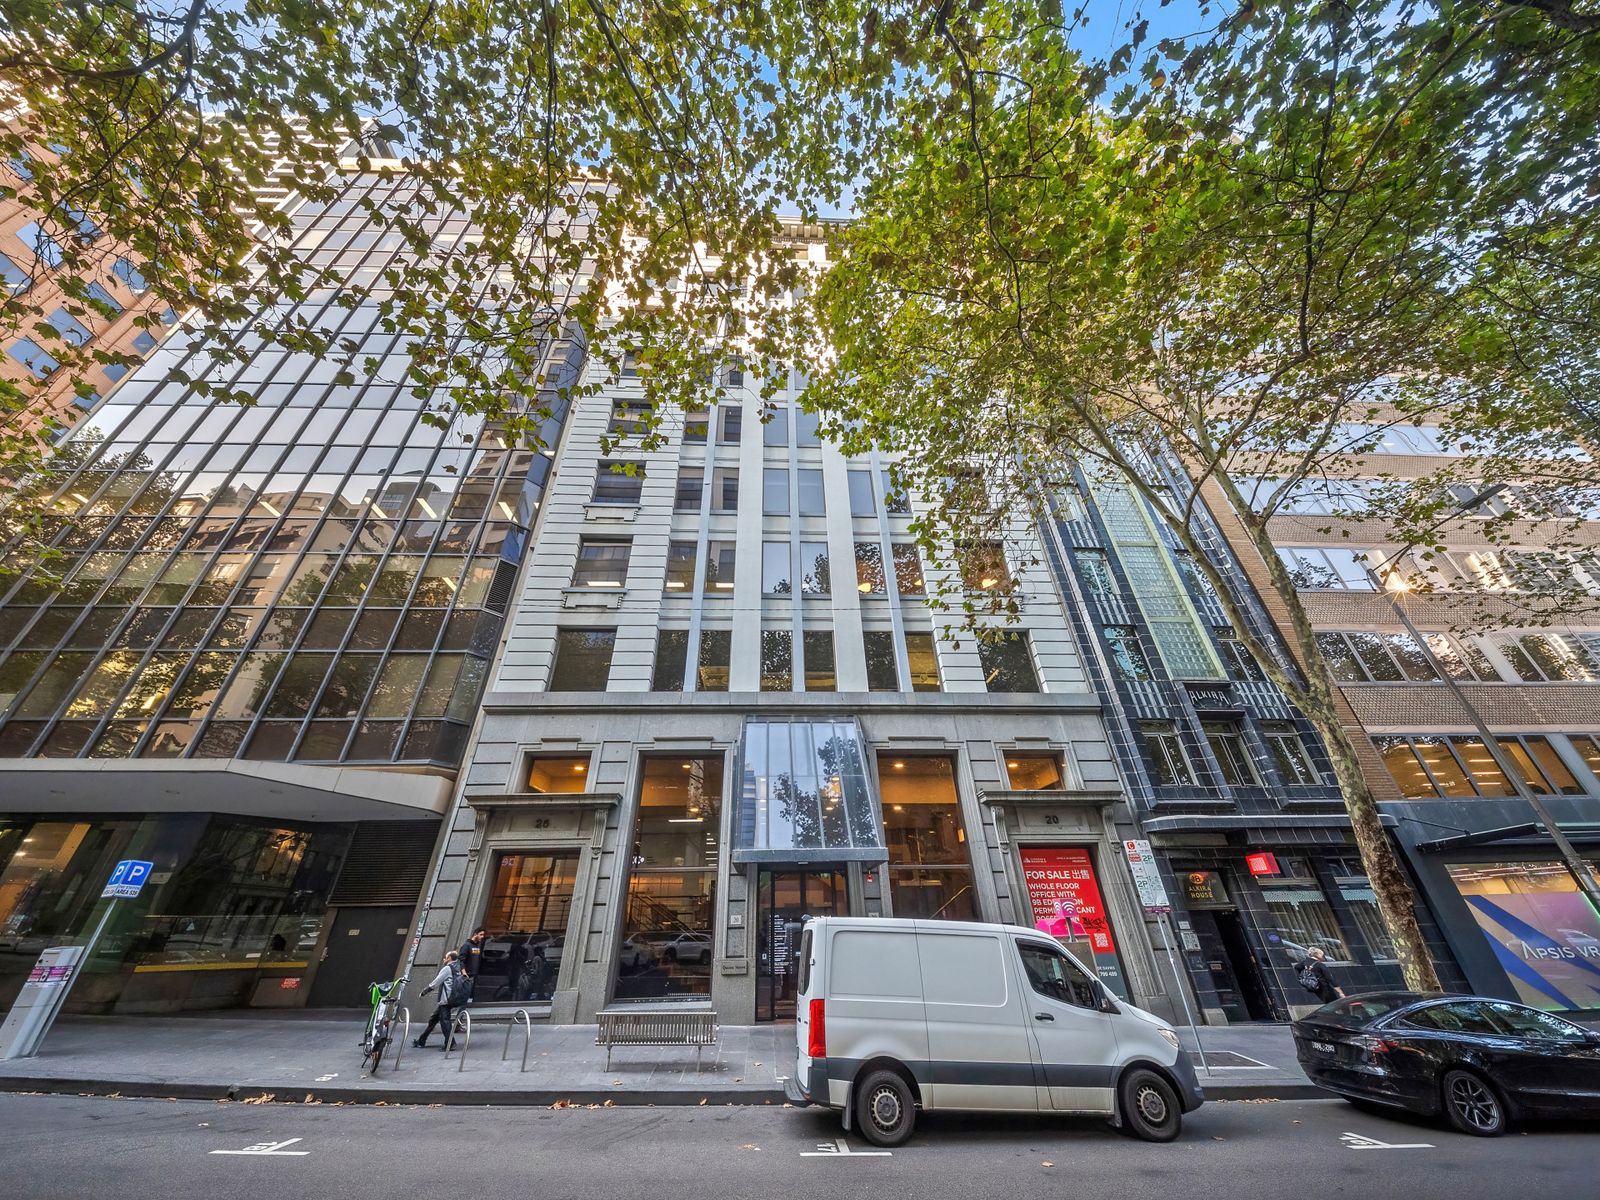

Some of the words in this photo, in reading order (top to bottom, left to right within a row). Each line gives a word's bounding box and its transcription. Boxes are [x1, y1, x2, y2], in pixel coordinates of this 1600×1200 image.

[1189, 691, 1229, 704] ALKIRA
[1045, 815, 1059, 825] 20
[1142, 854, 1153, 862] 2P
[112, 866, 124, 881] P
[128, 866, 144, 881] P
[1025, 870, 1046, 880] FOR
[1047, 870, 1070, 879] SALE
[1028, 882, 1055, 890] WHOLE
[1055, 882, 1080, 890] FLOOR
